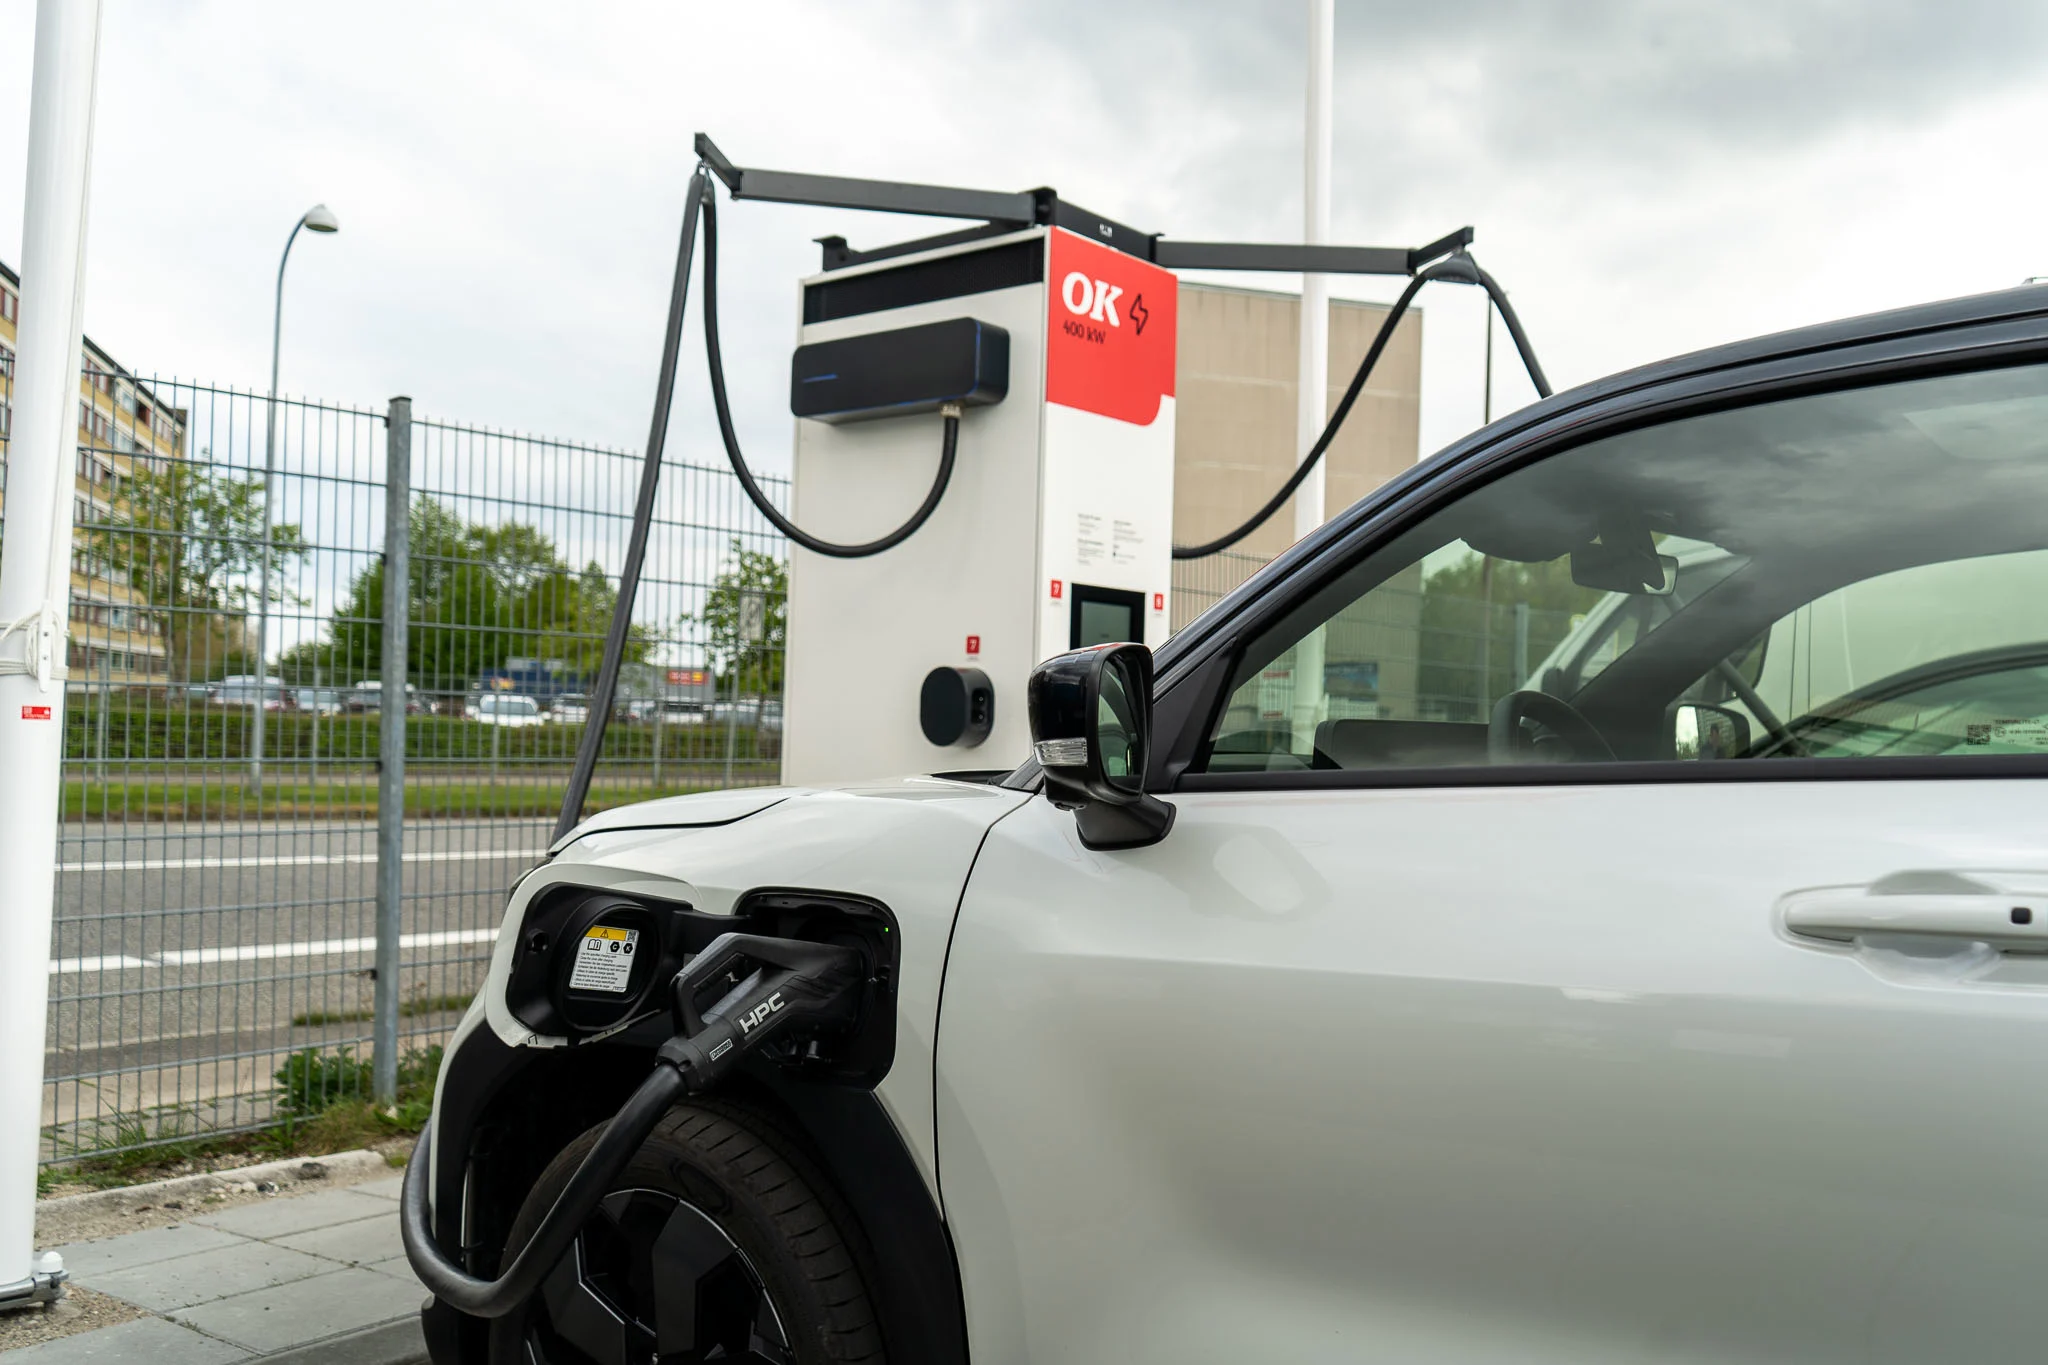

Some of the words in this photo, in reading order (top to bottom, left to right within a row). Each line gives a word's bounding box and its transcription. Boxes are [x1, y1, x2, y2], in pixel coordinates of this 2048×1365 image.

[1062, 270, 1123, 328] OK
[1063, 320, 1084, 339] 400
[1086, 326, 1106, 345] kW
[738, 991, 785, 1034] HPC
